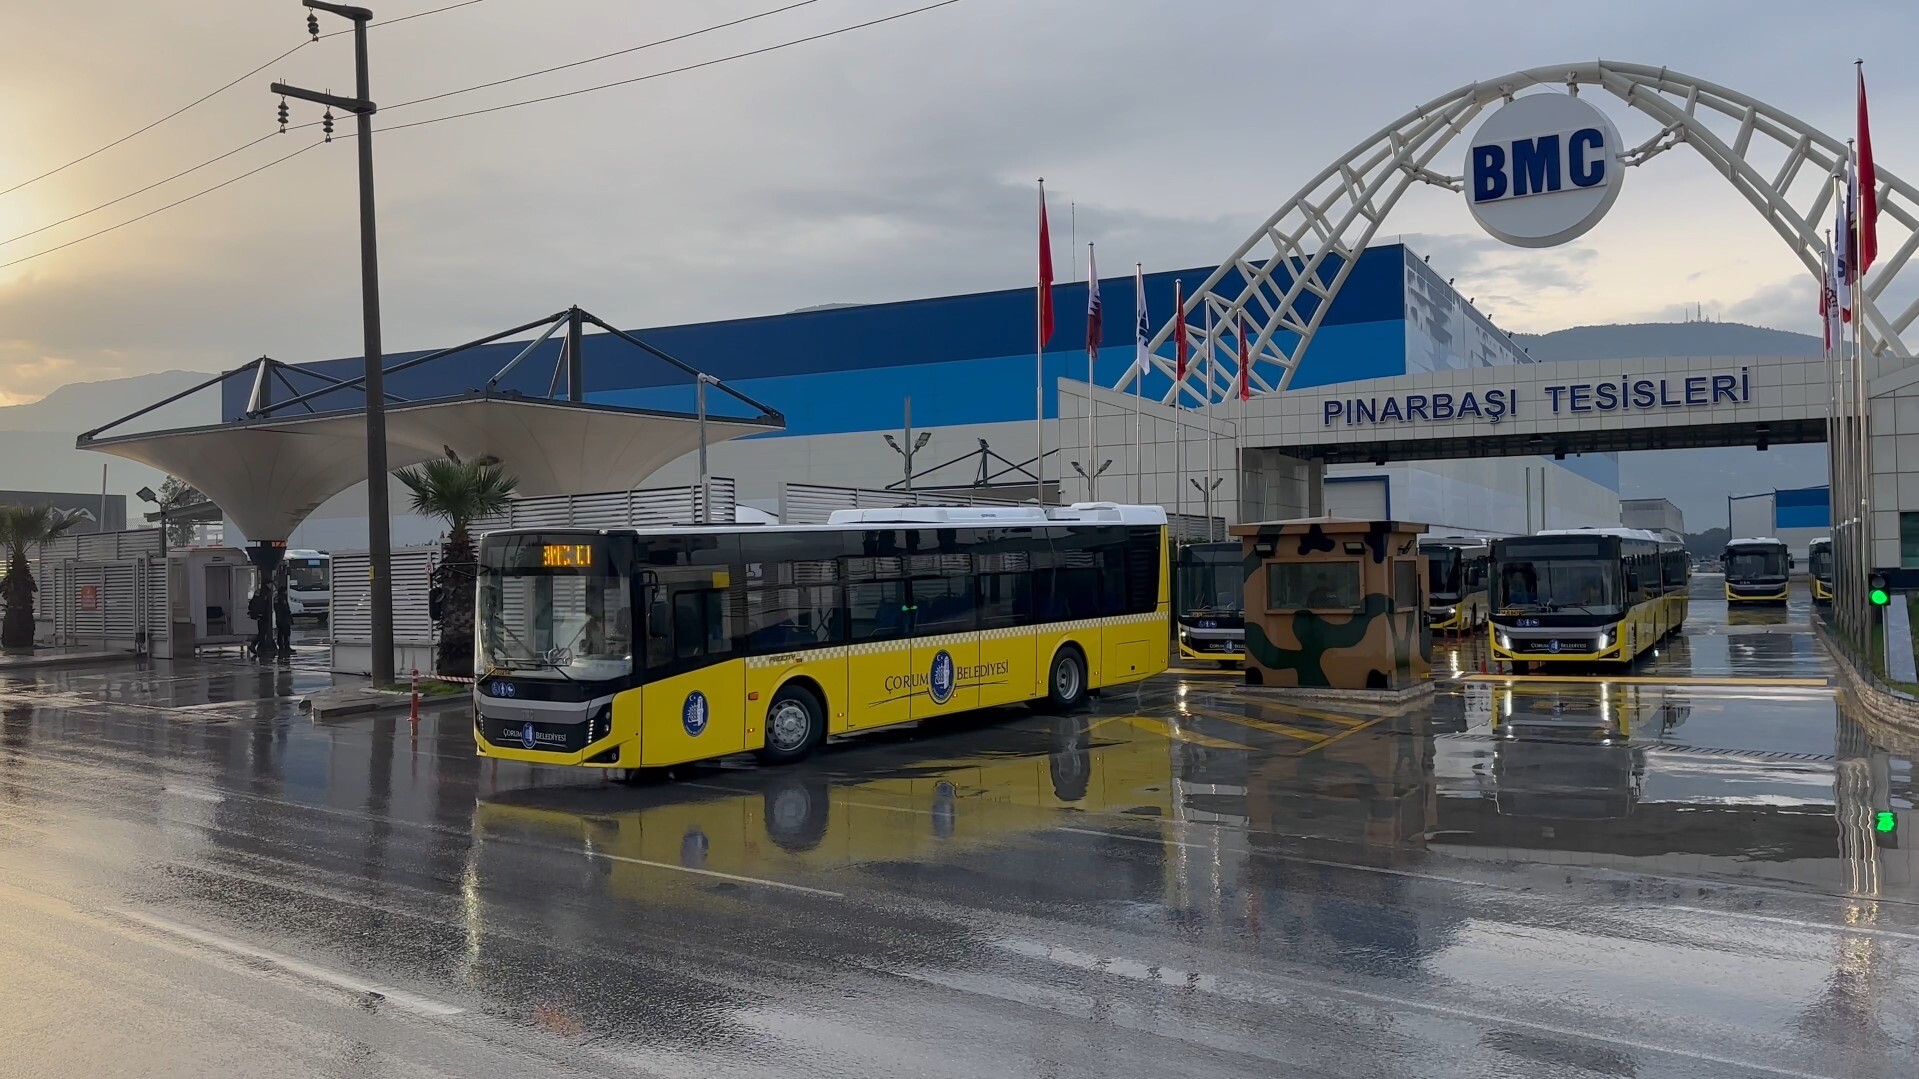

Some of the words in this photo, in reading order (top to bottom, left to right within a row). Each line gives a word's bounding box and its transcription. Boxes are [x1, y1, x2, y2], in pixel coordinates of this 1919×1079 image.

[1473, 128, 1605, 202] BMC
[1324, 388, 1518, 425] PINARBAŞI
[1543, 366, 1751, 413] TESİSLERİ
[53, 506, 97, 522] YA
[884, 671, 929, 694] ÇORUM
[957, 659, 1009, 681] BELEDİYESİ
[502, 728, 523, 738] ÇORUM
[535, 731, 567, 742] BELEDİYESİ
